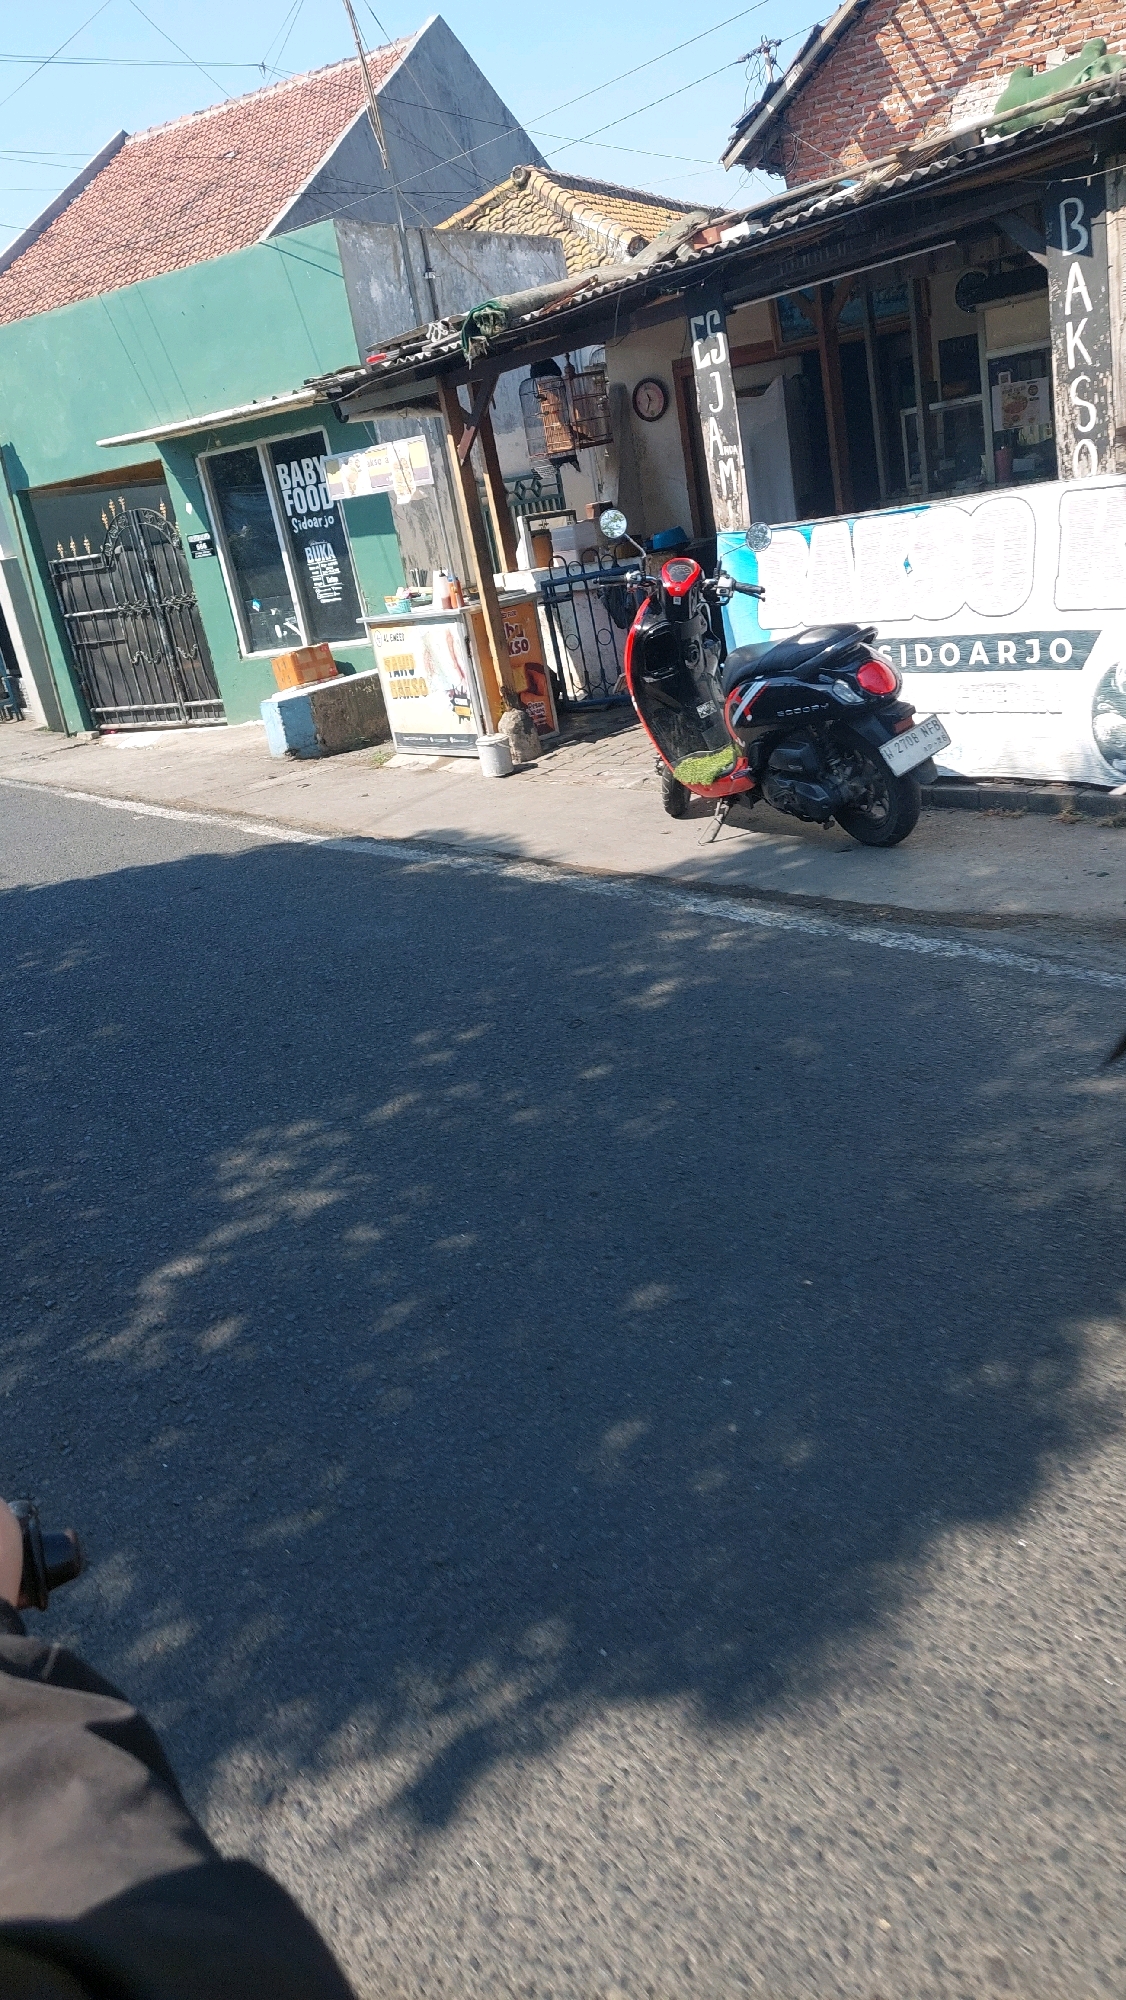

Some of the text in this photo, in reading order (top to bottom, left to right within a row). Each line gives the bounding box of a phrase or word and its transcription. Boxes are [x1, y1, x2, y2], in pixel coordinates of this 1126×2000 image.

[1059, 198, 1098, 479] BAKSO
[276, 455, 326, 490] BABY
[282, 483, 334, 516] FOOD
[291, 514, 335, 533] Sidoarjo
[304, 543, 337, 563] BUKA
[878, 638, 1073, 667] SIDOARJO
[776, 702, 829, 717] SCOOPY
[894, 733, 920, 754] 2708
[920, 719, 941, 737] NFB
